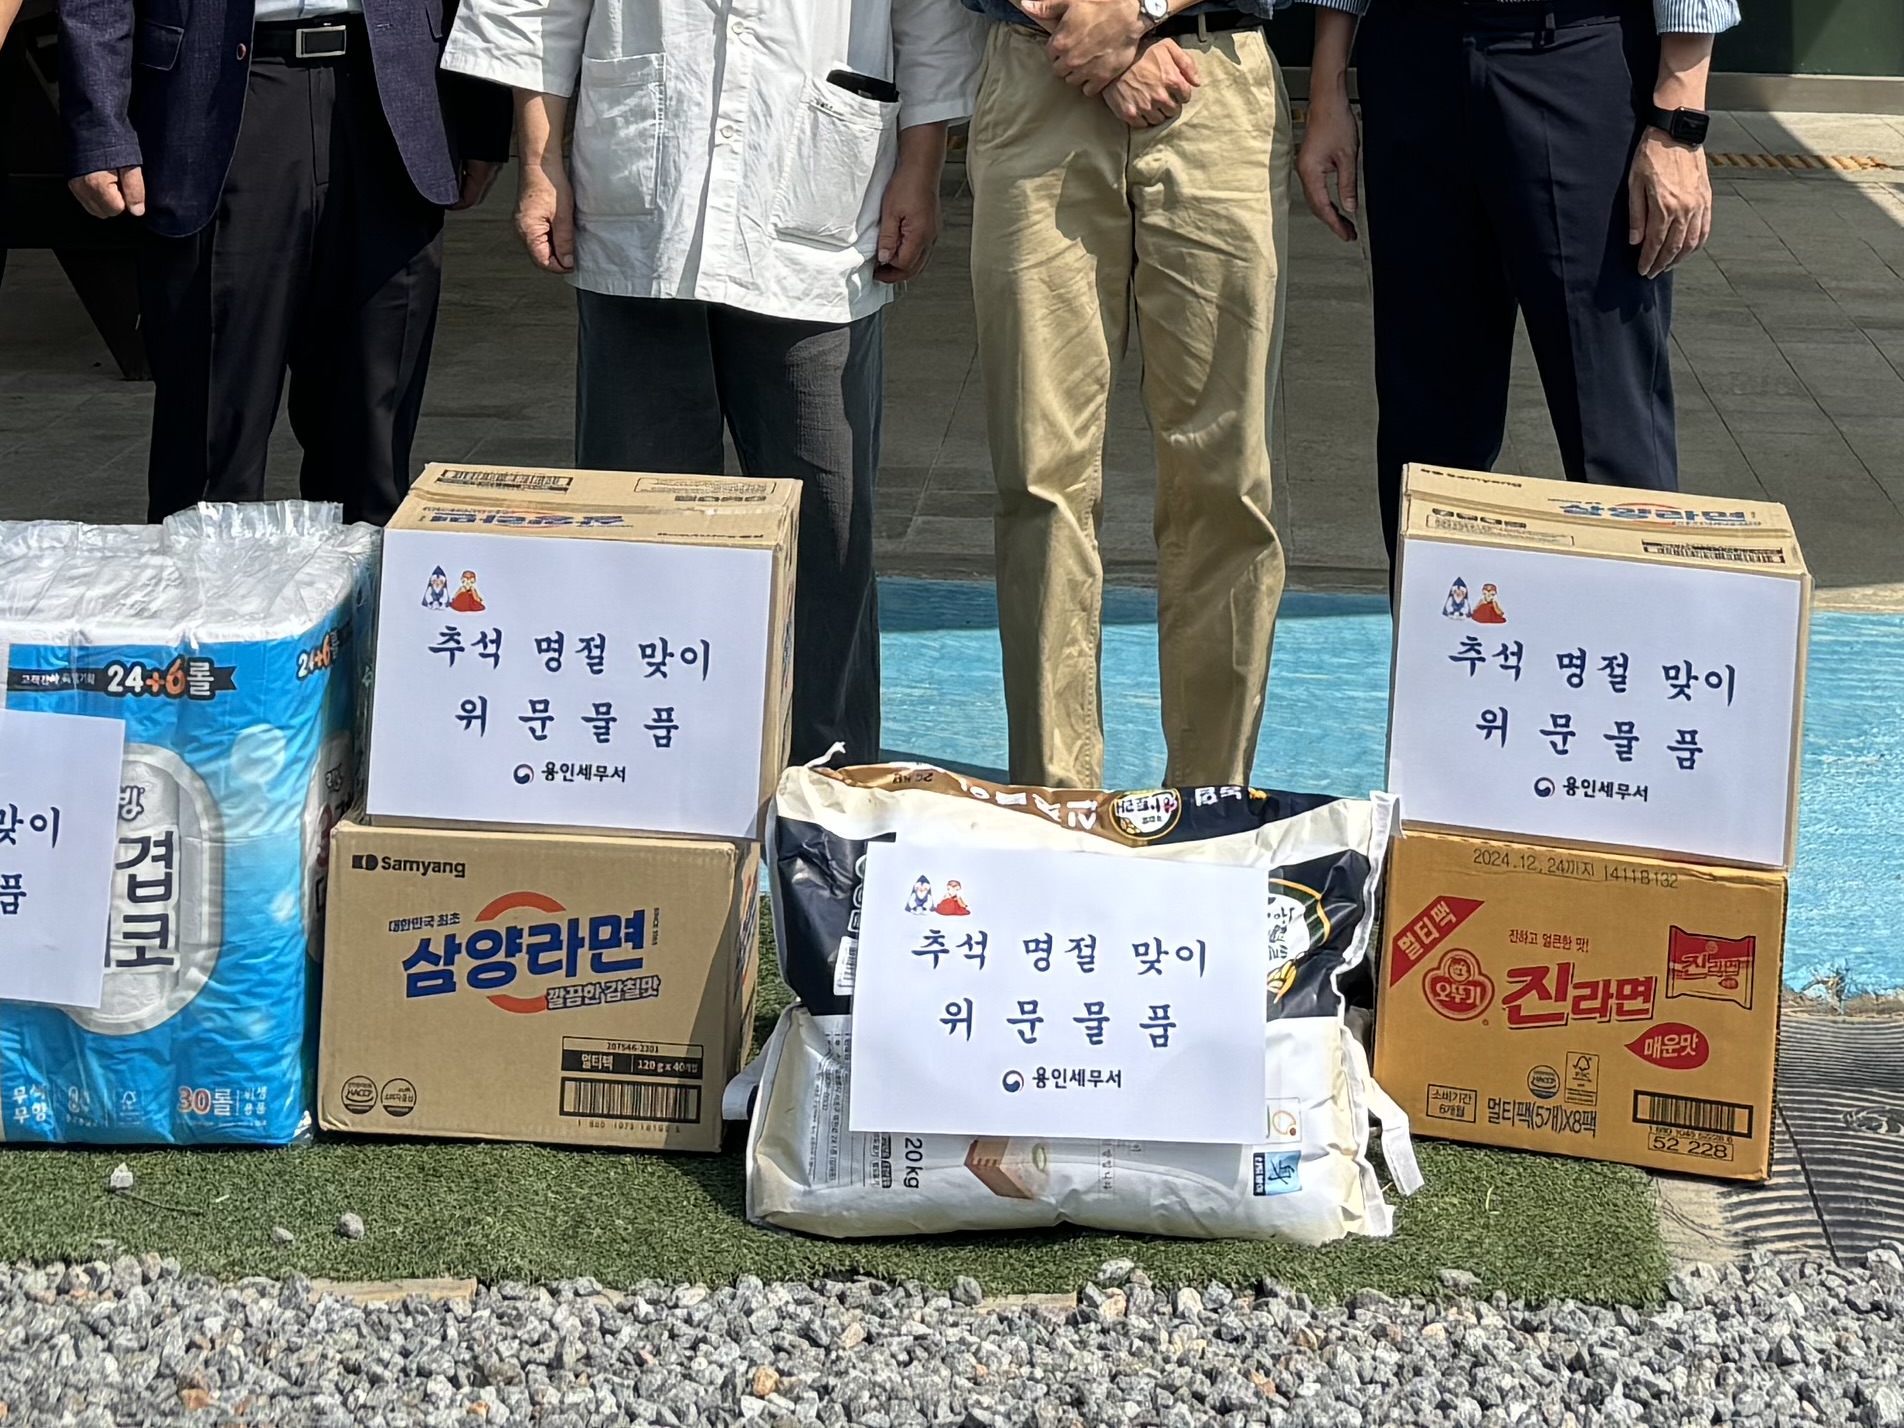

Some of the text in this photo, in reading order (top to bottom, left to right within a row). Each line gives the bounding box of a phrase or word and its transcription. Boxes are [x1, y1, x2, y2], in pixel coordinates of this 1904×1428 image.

[427, 625, 710, 682] 추석 명절 맞이
[1448, 635, 1736, 707] 추석 명절 맞이
[541, 761, 626, 783] 용인세무서
[1562, 775, 1649, 803] 용인세무서
[381, 856, 466, 879] Samyang
[388, 912, 460, 932] 대한민국 최초
[1397, 900, 1457, 961] 멀티팩
[402, 909, 645, 998] 삼양라면
[911, 928, 1206, 978] 추석 명절 맞이
[1542, 933, 1572, 950] 얼큰한
[1576, 937, 1589, 953] 맛!
[1681, 952, 1741, 979] 진라면
[546, 975, 661, 1011] 깔끔한 감칠맛
[1435, 982, 1482, 1005] 오뚜기
[1501, 961, 1658, 1028] 진라면
[1643, 1033, 1700, 1059] 매운맛
[581, 1053, 614, 1071] 멀티팩
[1031, 1066, 1122, 1090] 용인세무서
[178, 1085, 233, 1117] 30롤
[1431, 1089, 1472, 1105] 소비기간
[1439, 1103, 1466, 1119] 6개월
[1653, 1135, 1728, 1159] 52 228
